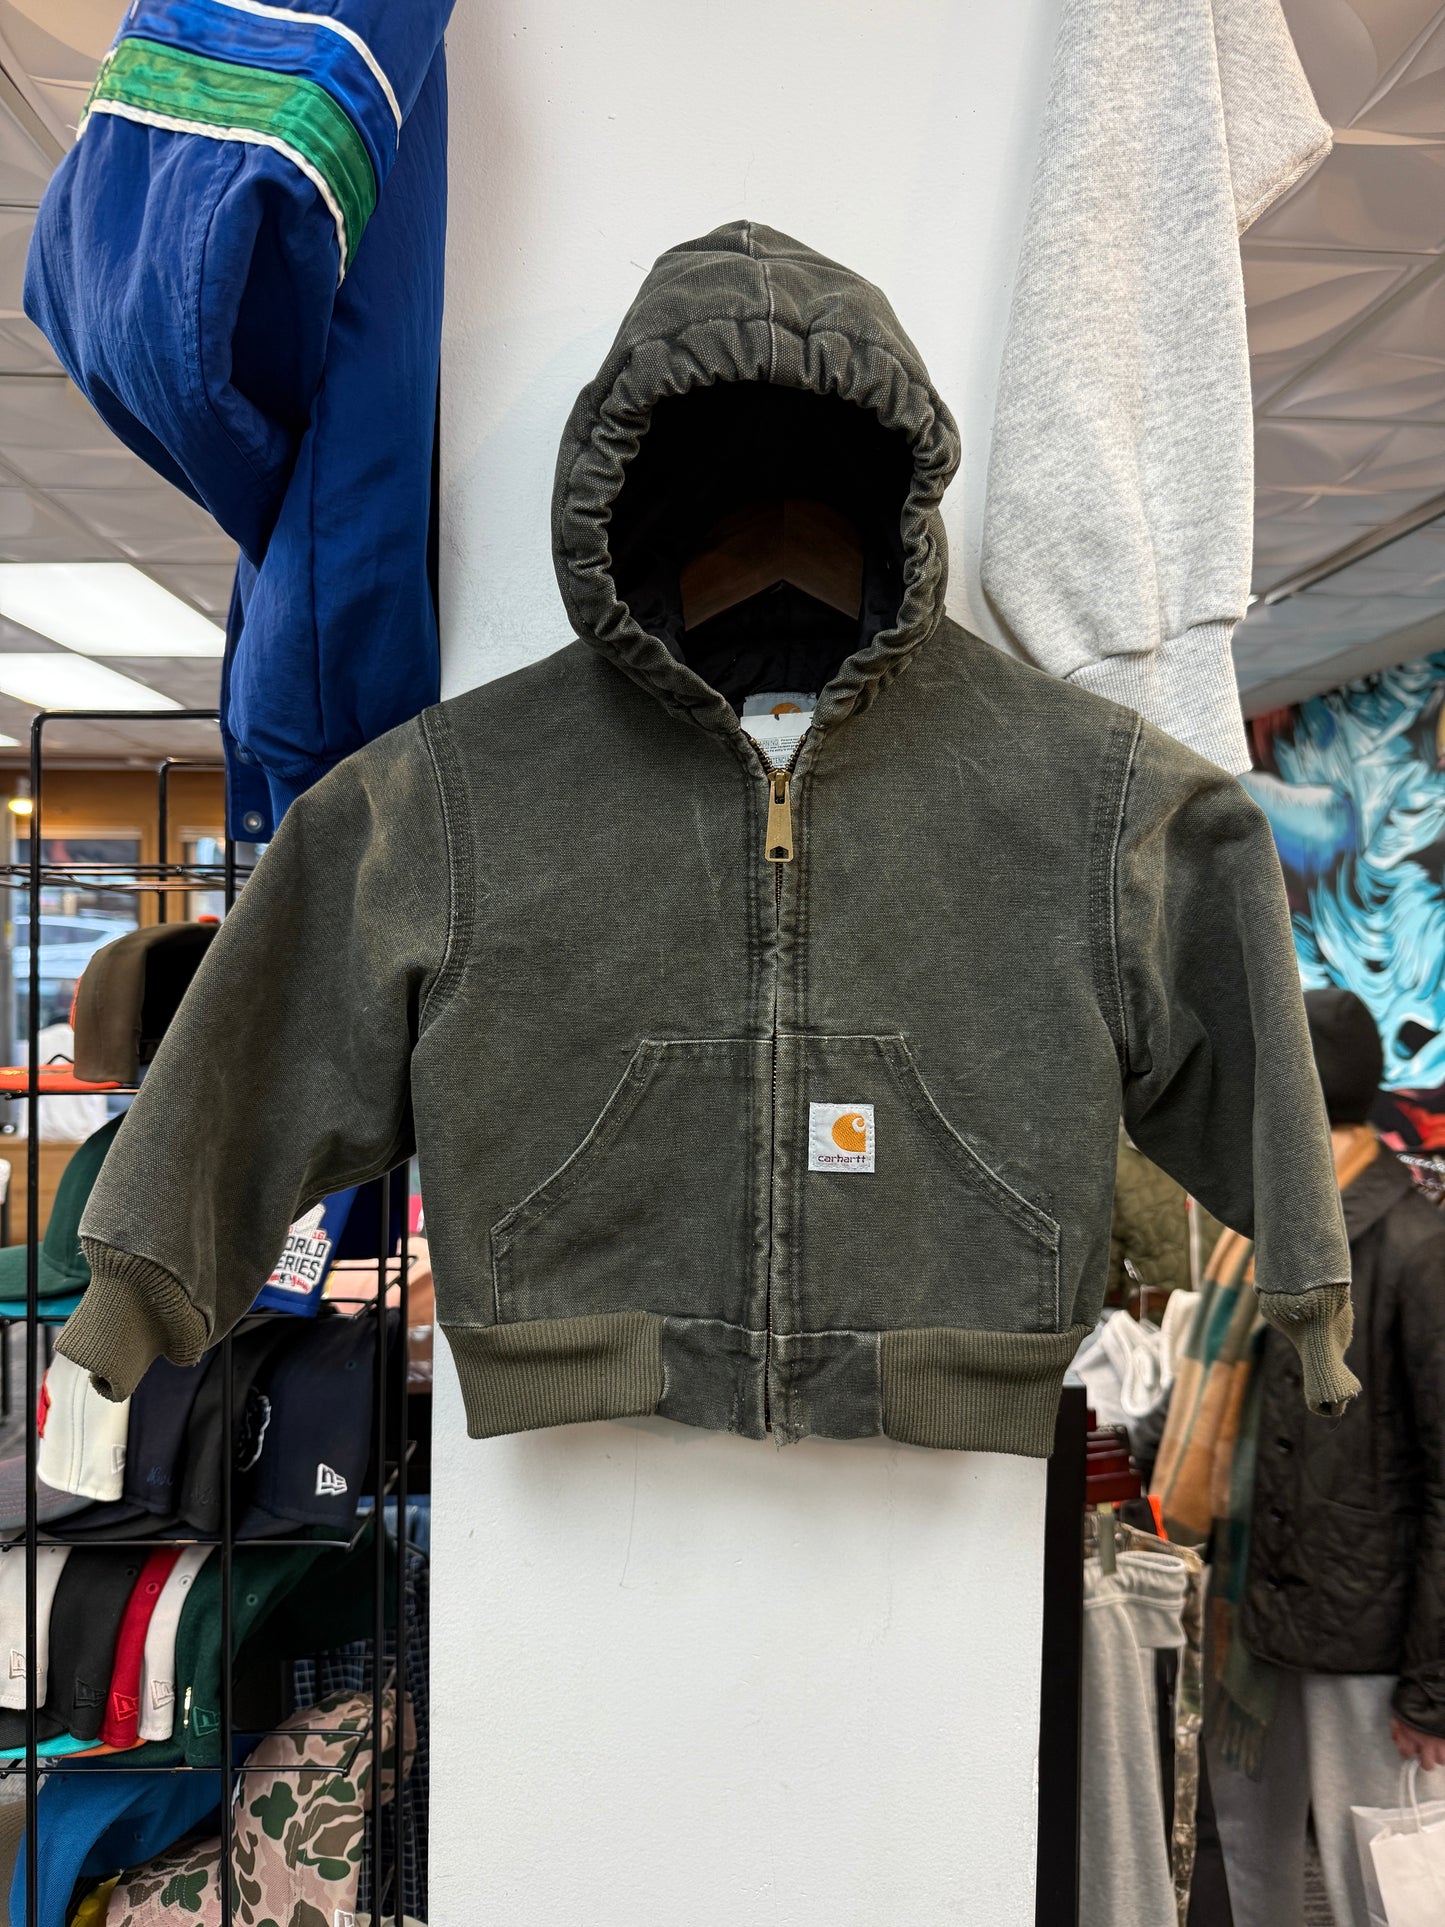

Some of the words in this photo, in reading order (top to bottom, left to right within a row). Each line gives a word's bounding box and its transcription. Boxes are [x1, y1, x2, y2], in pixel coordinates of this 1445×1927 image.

[817, 1154, 866, 1163] carhartt
[284, 1236, 326, 1258] ORLD
[276, 1253, 320, 1281] RIES
